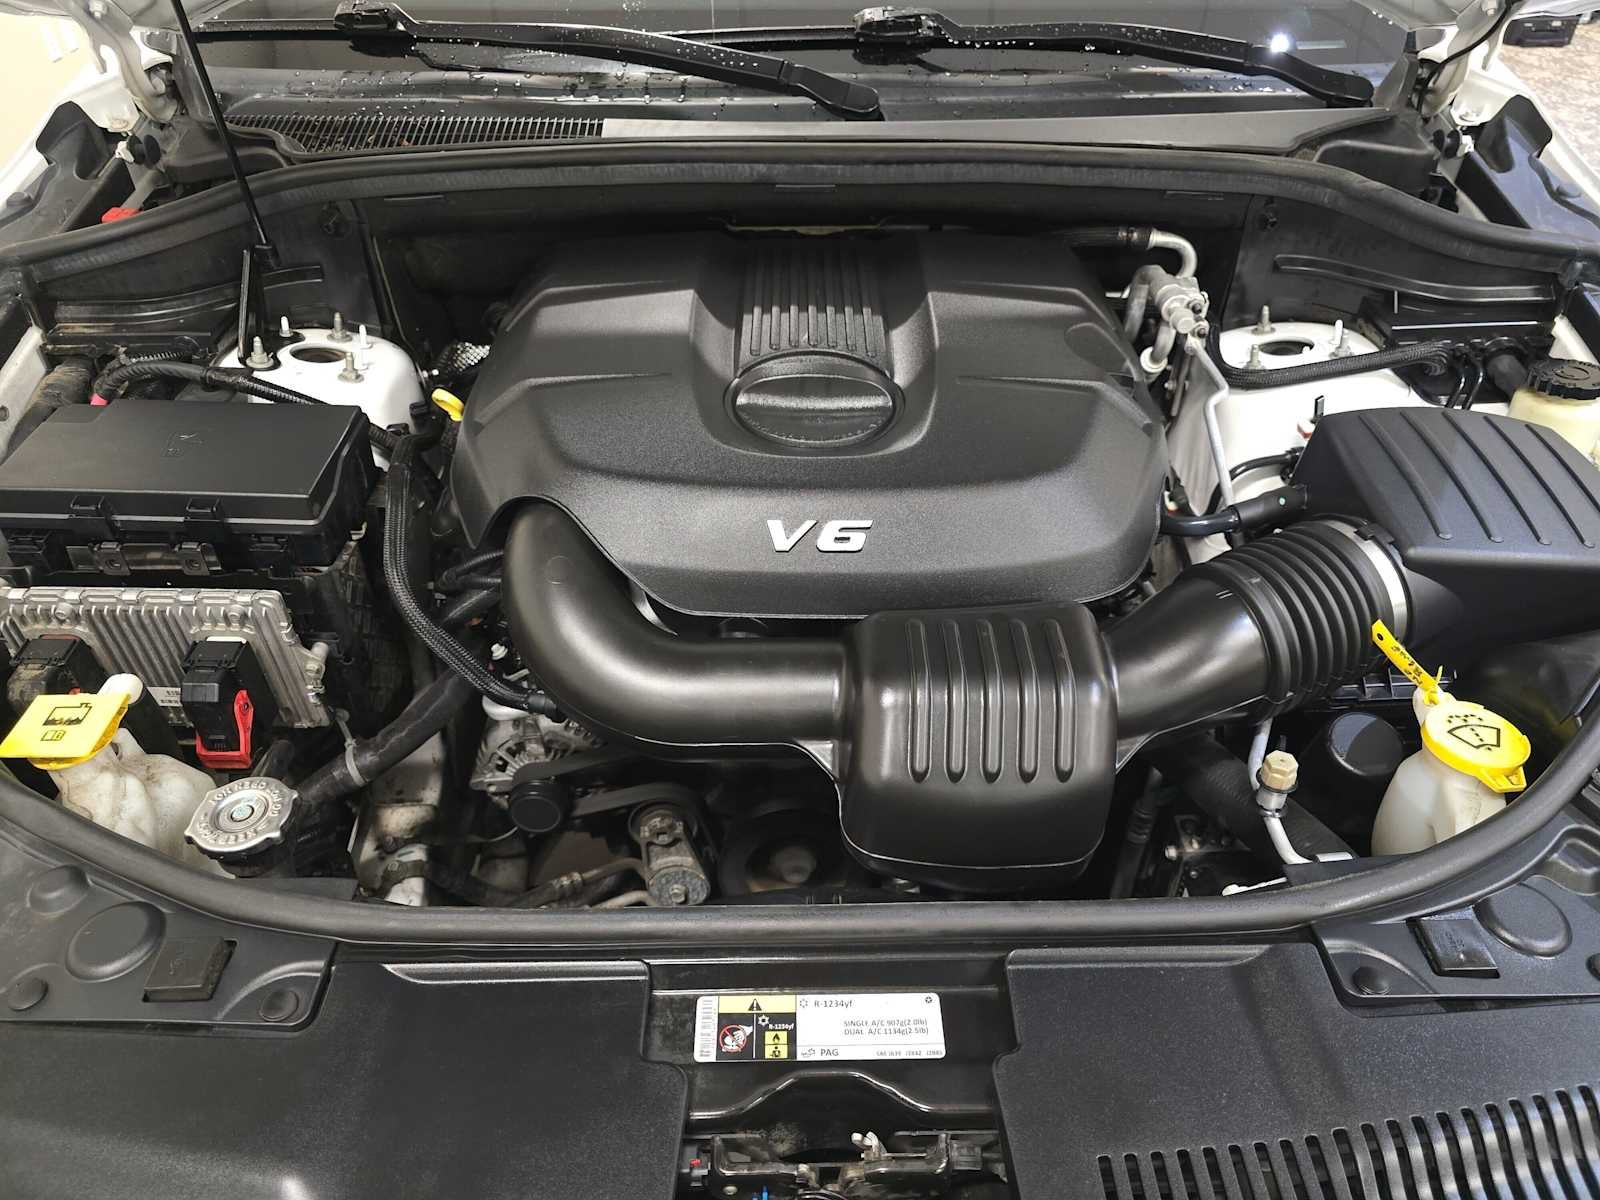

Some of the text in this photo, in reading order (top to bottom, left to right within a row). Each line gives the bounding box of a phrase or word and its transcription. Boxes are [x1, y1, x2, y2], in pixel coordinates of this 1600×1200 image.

[766, 519, 874, 553] V6
[814, 999, 853, 1009] R-1234yf
[843, 1019, 868, 1027] SINGLE
[871, 1018, 885, 1027] A/C
[843, 1028, 864, 1036] DUAL
[867, 1027, 881, 1036] A/C
[820, 1048, 839, 1057] PAG
